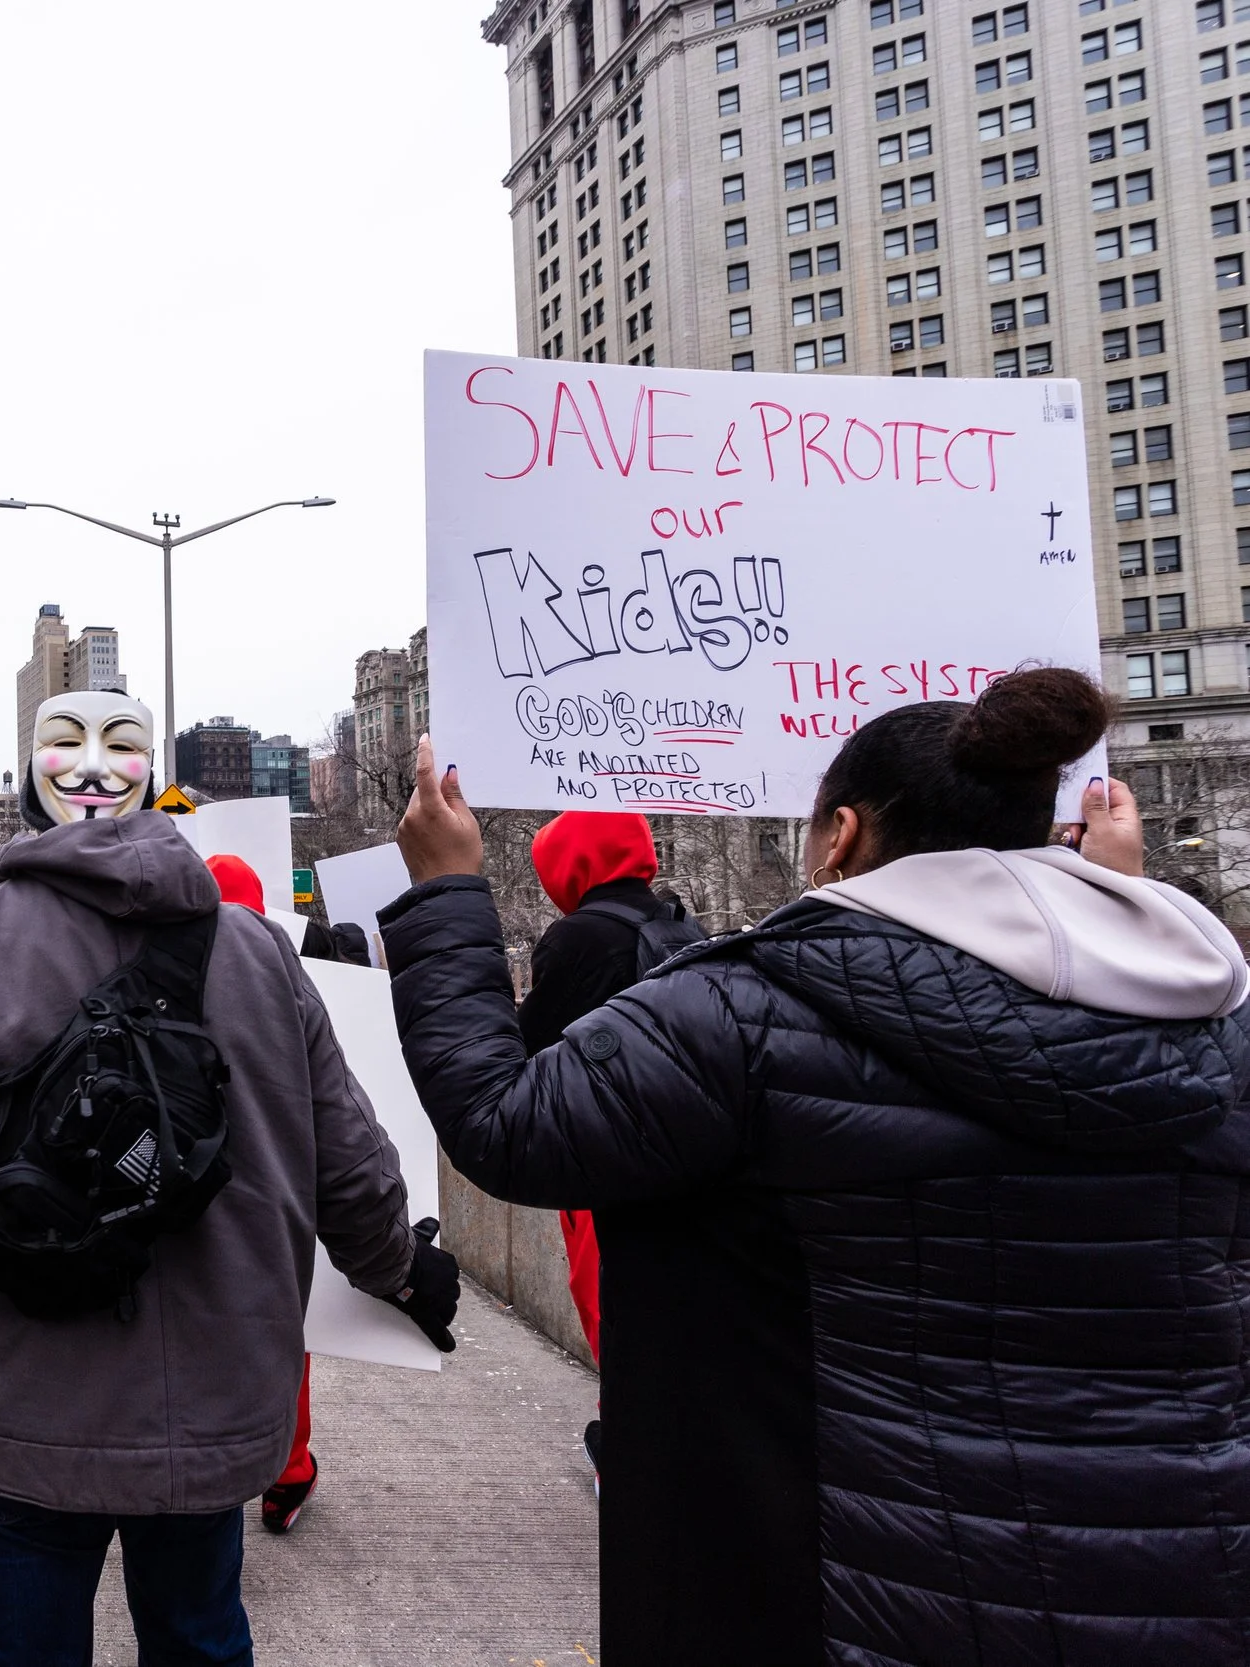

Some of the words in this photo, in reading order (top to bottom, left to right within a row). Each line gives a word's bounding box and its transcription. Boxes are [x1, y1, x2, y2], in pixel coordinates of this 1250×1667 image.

[466, 366, 694, 480] SAVE
[749, 401, 1018, 492] PROTECT
[650, 500, 744, 539] our
[772, 657, 870, 706] THE
[881, 659, 1008, 701] SYSTE
[516, 685, 645, 746] GOD'S
[643, 698, 743, 729] CHILDREN
[530, 743, 567, 768] ARE
[579, 750, 701, 775] ANOINTED
[557, 775, 598, 799] AND
